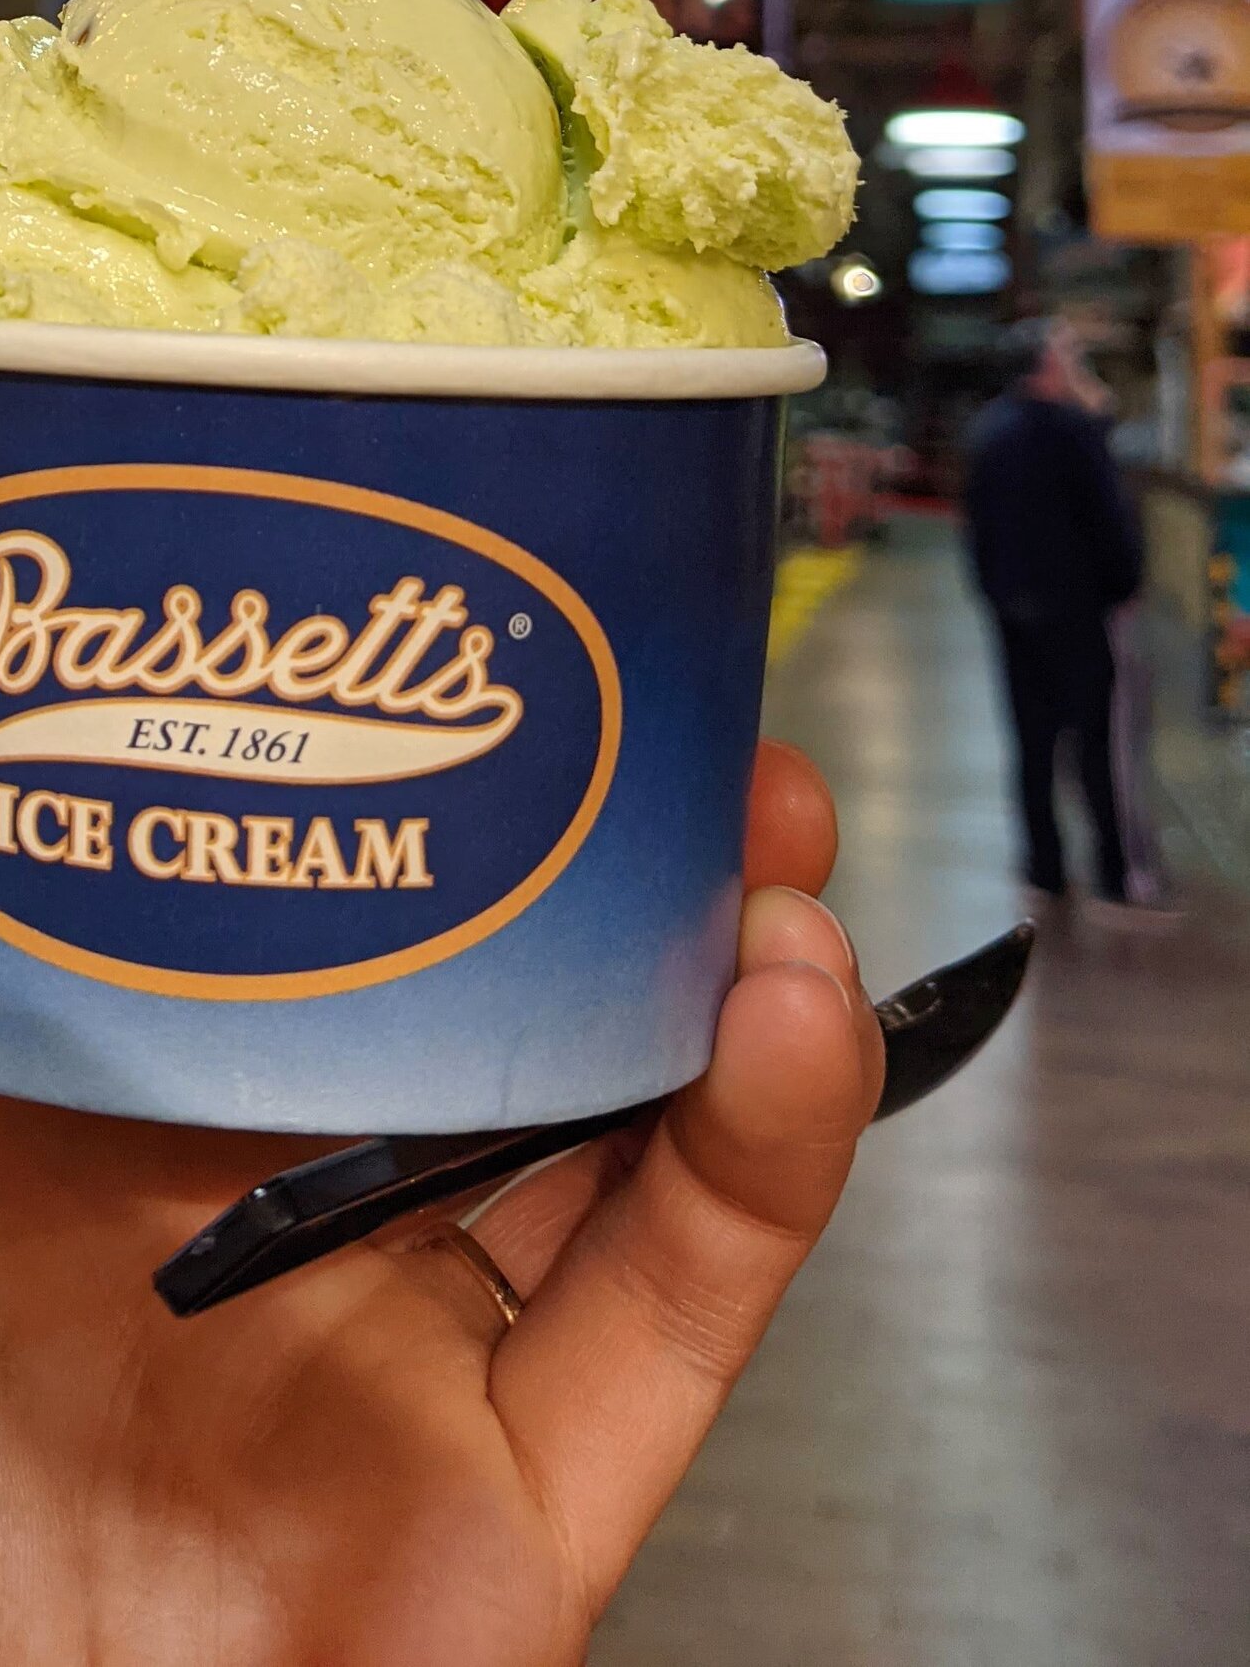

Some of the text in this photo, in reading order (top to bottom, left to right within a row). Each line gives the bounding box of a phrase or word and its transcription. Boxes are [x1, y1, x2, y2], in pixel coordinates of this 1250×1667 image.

[127, 718, 311, 766] EST. 1861
[126, 803, 434, 890] CREAM
